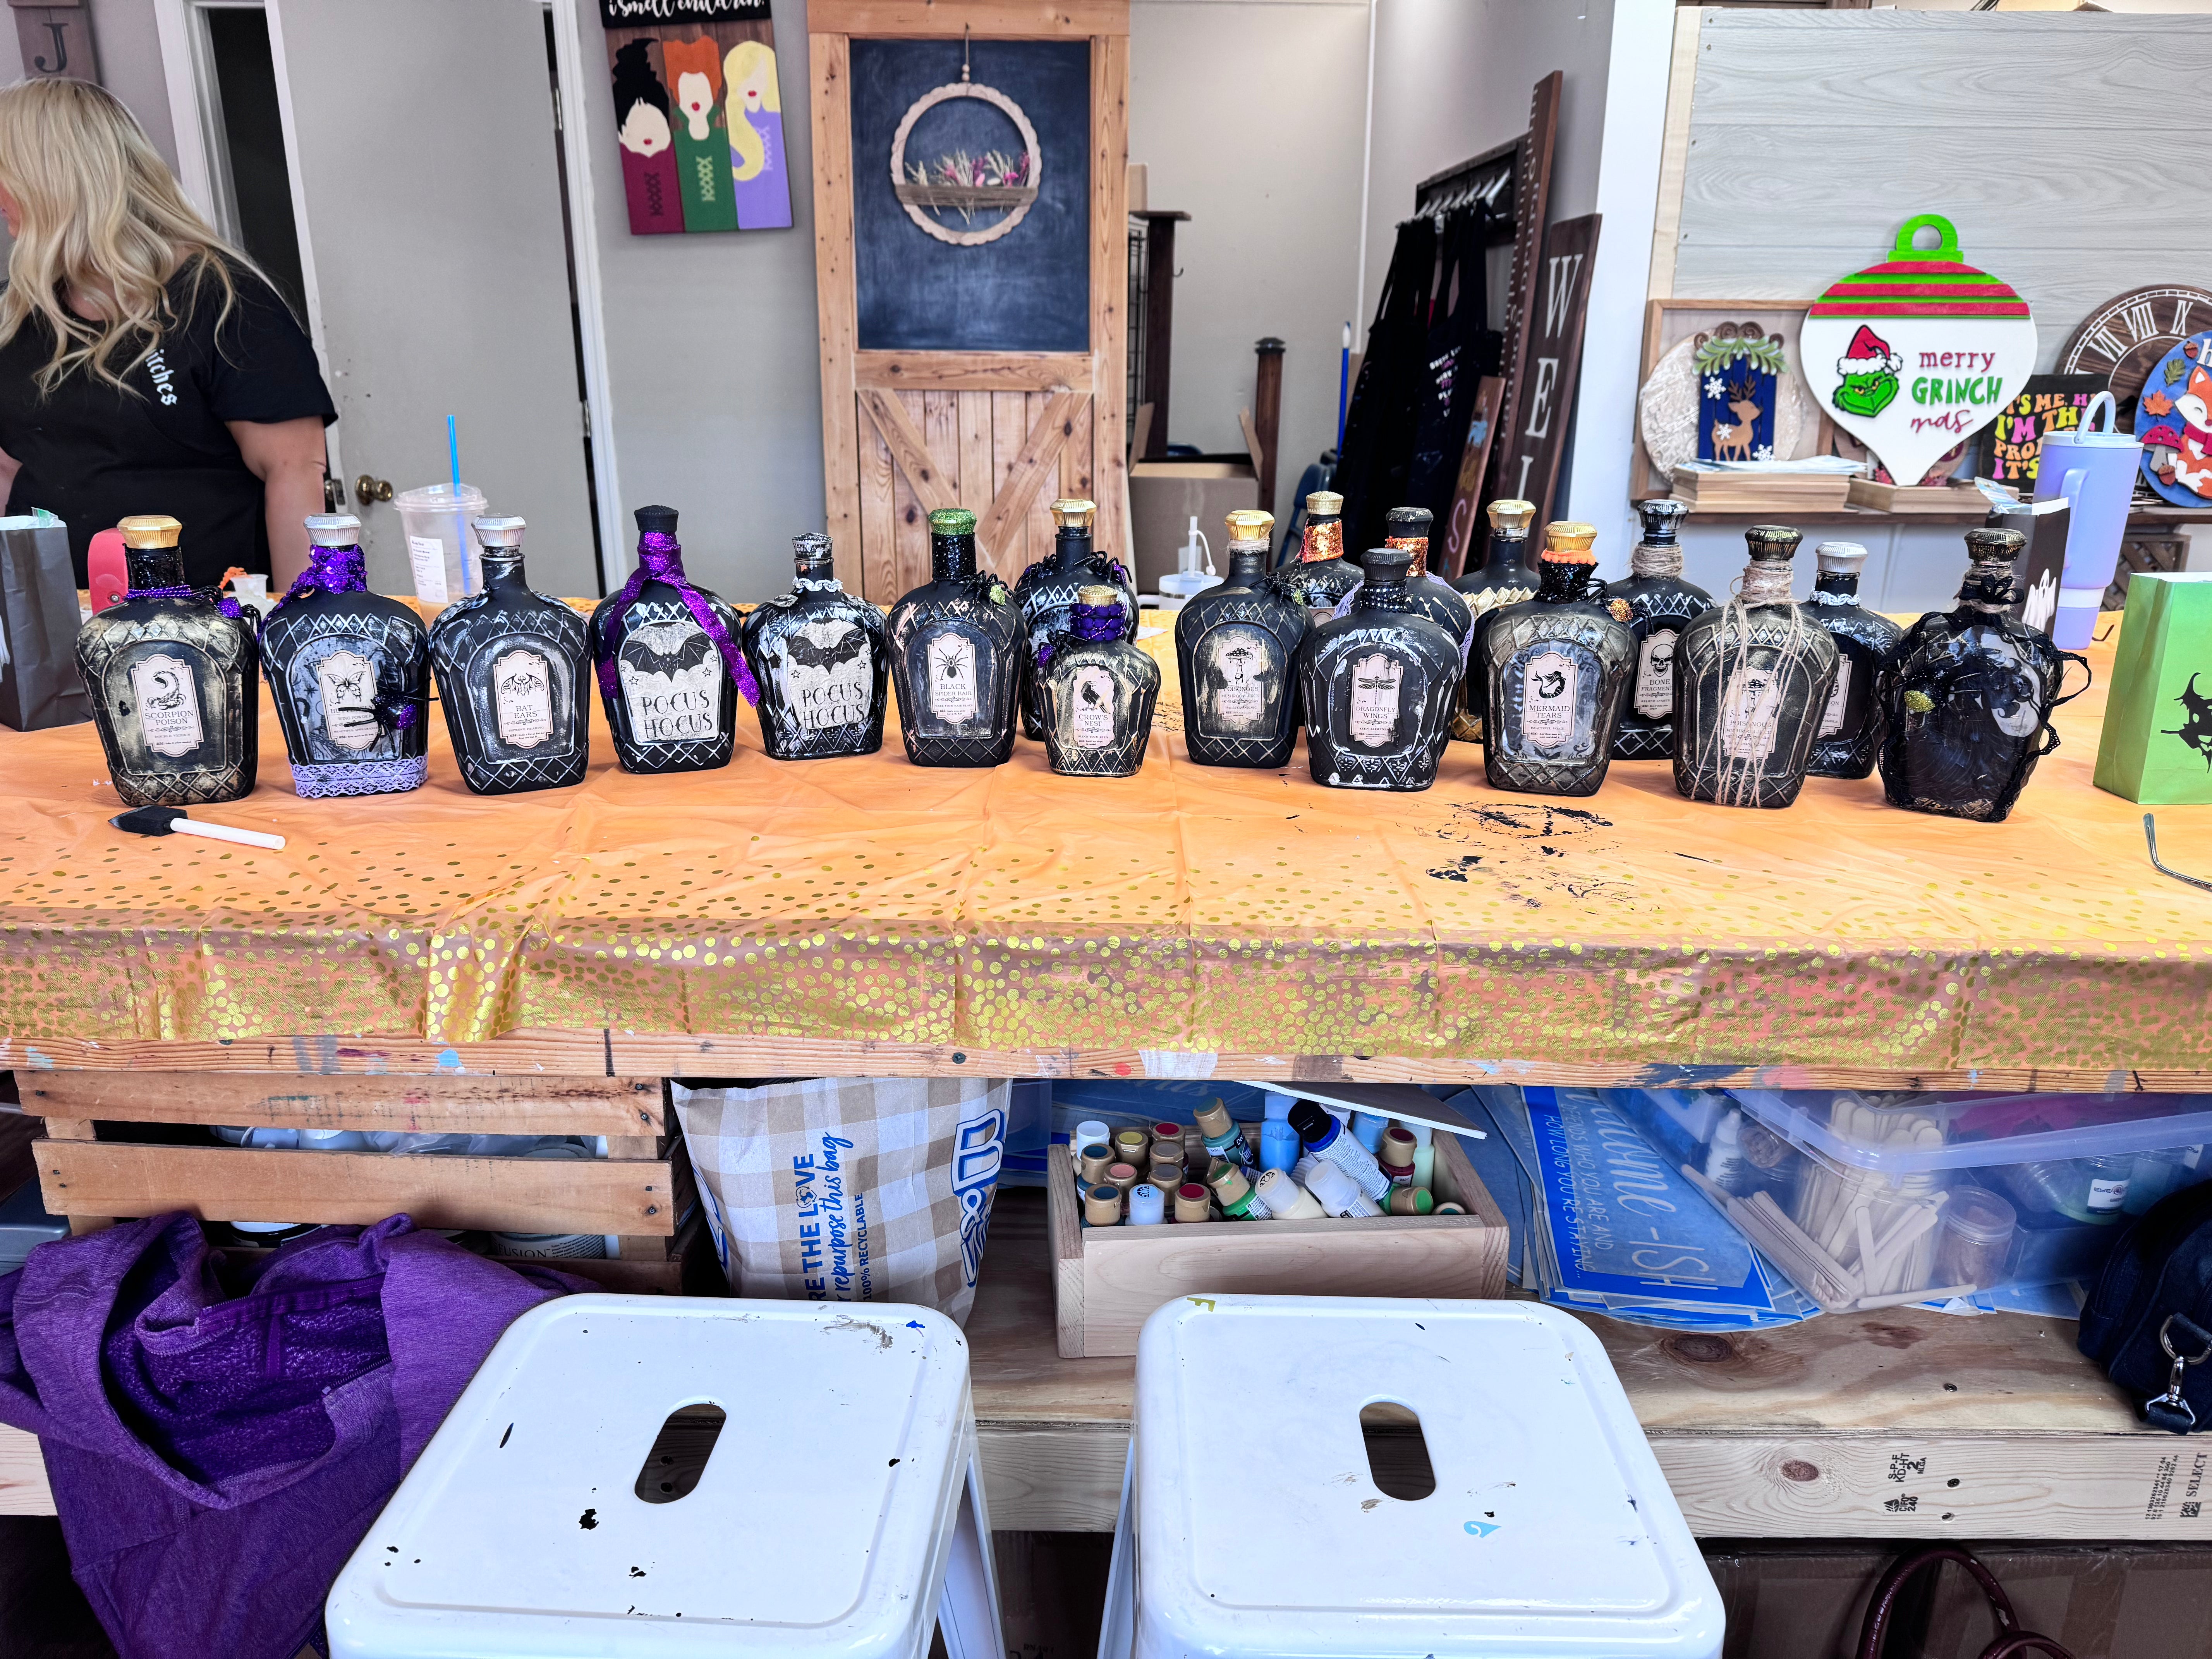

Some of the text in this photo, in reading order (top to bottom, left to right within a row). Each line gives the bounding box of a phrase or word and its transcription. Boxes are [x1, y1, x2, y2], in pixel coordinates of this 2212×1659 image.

[34, 23, 69, 73] J
[1919, 351, 1996, 372] merry
[144, 348, 178, 405] itches
[1912, 376, 2003, 405] GRINCH
[1910, 409, 1974, 433] mas
[1995, 414, 2036, 443] I'M
[642, 690, 709, 716] POCUS
[802, 682, 863, 707] POCUS
[145, 710, 194, 719] SCORPION
[644, 712, 713, 738] HOCUS
[803, 704, 865, 729] HOCUS
[815, 1131, 854, 1171] bag
[1549, 1140, 1570, 1168] LONG
[819, 1175, 844, 1212] this
[1580, 1172, 1602, 1195] YOU
[1586, 1197, 1609, 1222] ARE
[799, 1223, 823, 1277] THE
[854, 1192, 872, 1301] 100% RECYCLABLE
[1591, 1224, 1614, 1250] AND
[827, 1216, 855, 1291] repurpose
[1888, 1455, 1900, 1479] S-P-F
[1895, 1453, 1910, 1482] KD-HT
[2186, 1452, 2207, 1497] SELECT
[1908, 1496, 1918, 1512] 240
